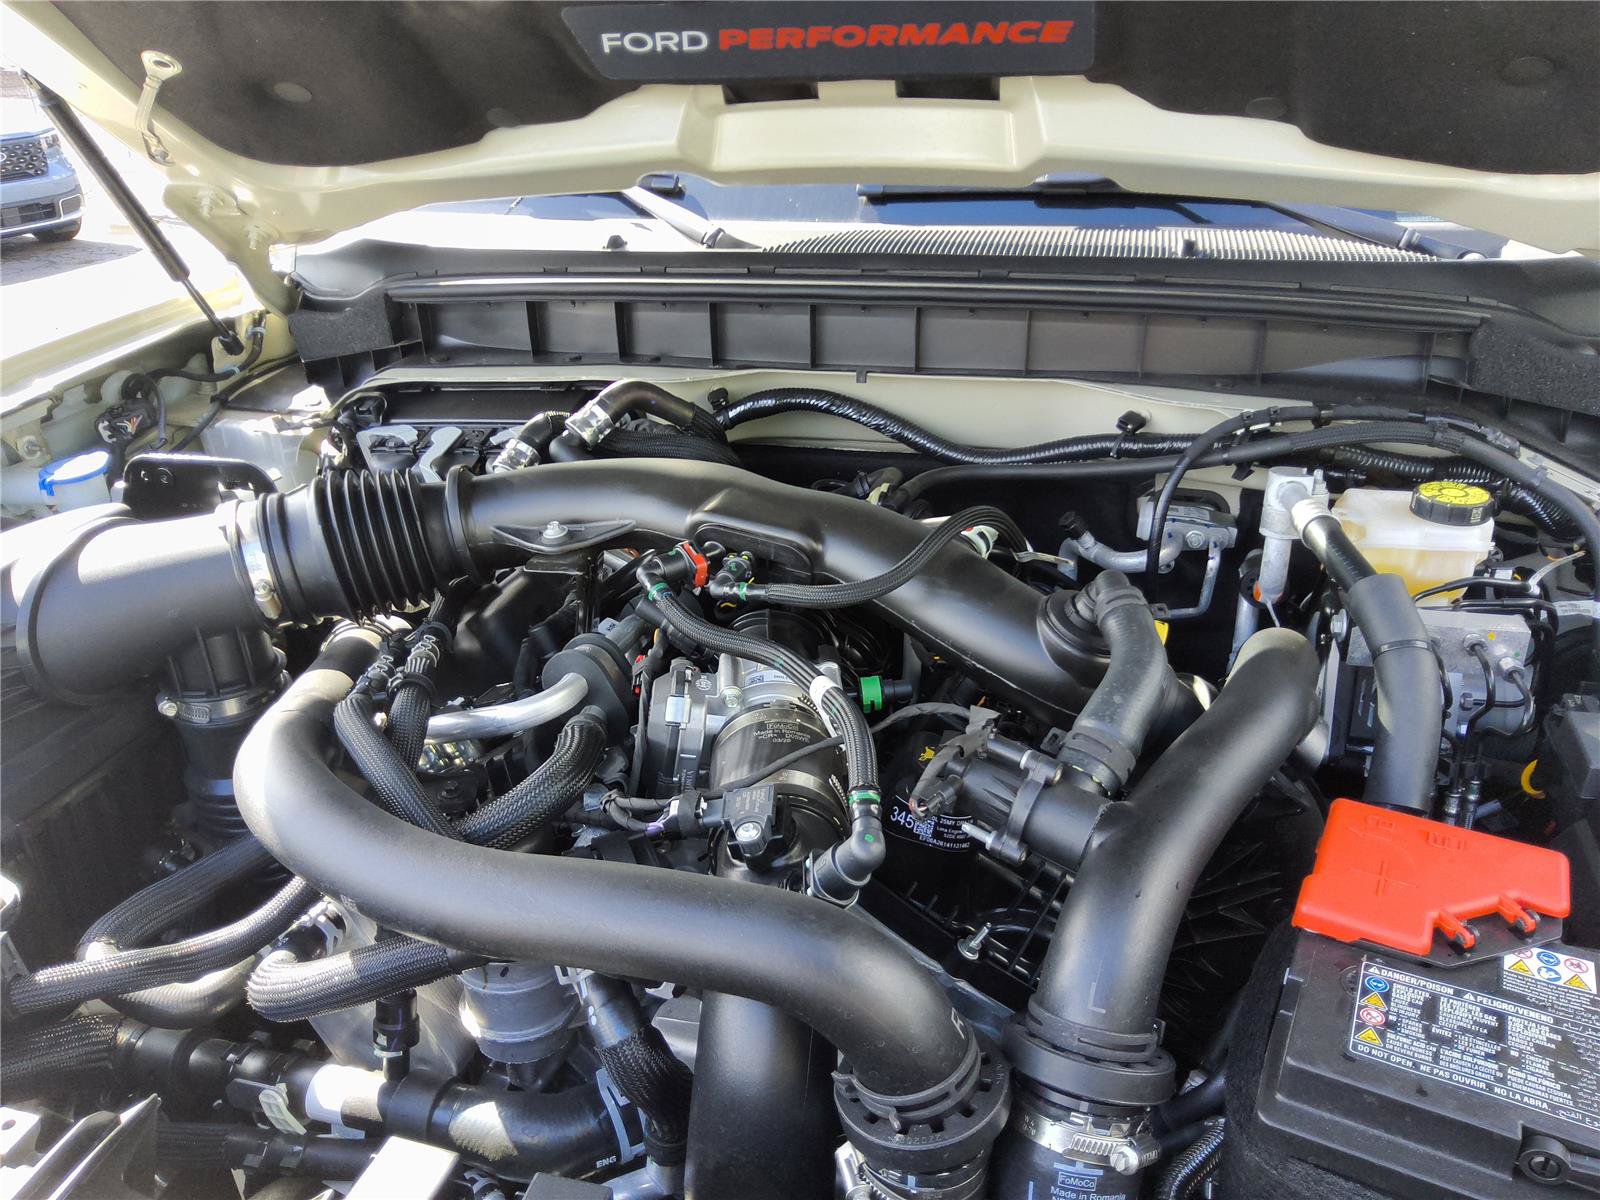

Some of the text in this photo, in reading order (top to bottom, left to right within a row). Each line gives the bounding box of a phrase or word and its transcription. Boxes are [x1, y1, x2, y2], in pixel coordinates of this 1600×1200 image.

[601, 20, 1075, 55] FORD PERFORMANCE
[891, 806, 914, 828] 345
[1381, 968, 1453, 995] DANGER/POISON
[1477, 995, 1552, 1023] PELIGRO/VENENO
[1358, 1044, 1415, 1068] DO NOT OPEN.
[1419, 1063, 1488, 1091] NE PAS OUVRIR.
[1495, 1086, 1551, 1110] NO LA ABRA.
[596, 1156, 617, 1168] ENG
[1050, 1186, 1076, 1200] Made
[1079, 1192, 1087, 1200] in
[1060, 1175, 1095, 1188] FoMoCo
